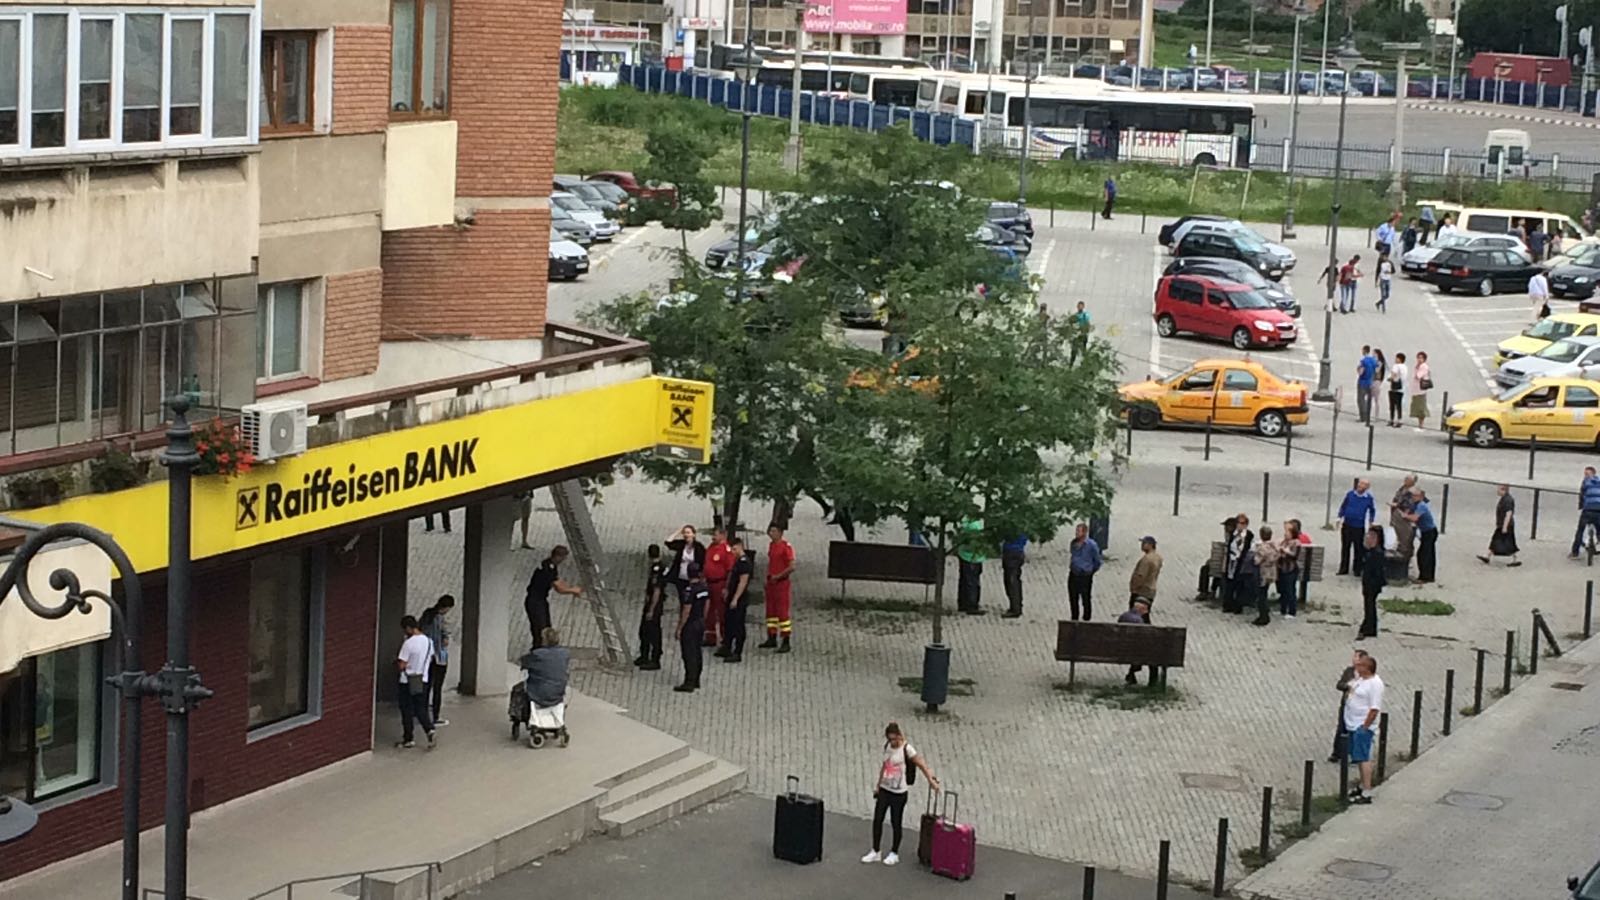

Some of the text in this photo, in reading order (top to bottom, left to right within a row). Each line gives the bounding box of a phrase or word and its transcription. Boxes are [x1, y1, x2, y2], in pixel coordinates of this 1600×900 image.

[662, 383, 705, 395] Raiffeisen
[670, 393, 696, 403] BANK
[264, 437, 480, 523] Raiffeisen BANK
